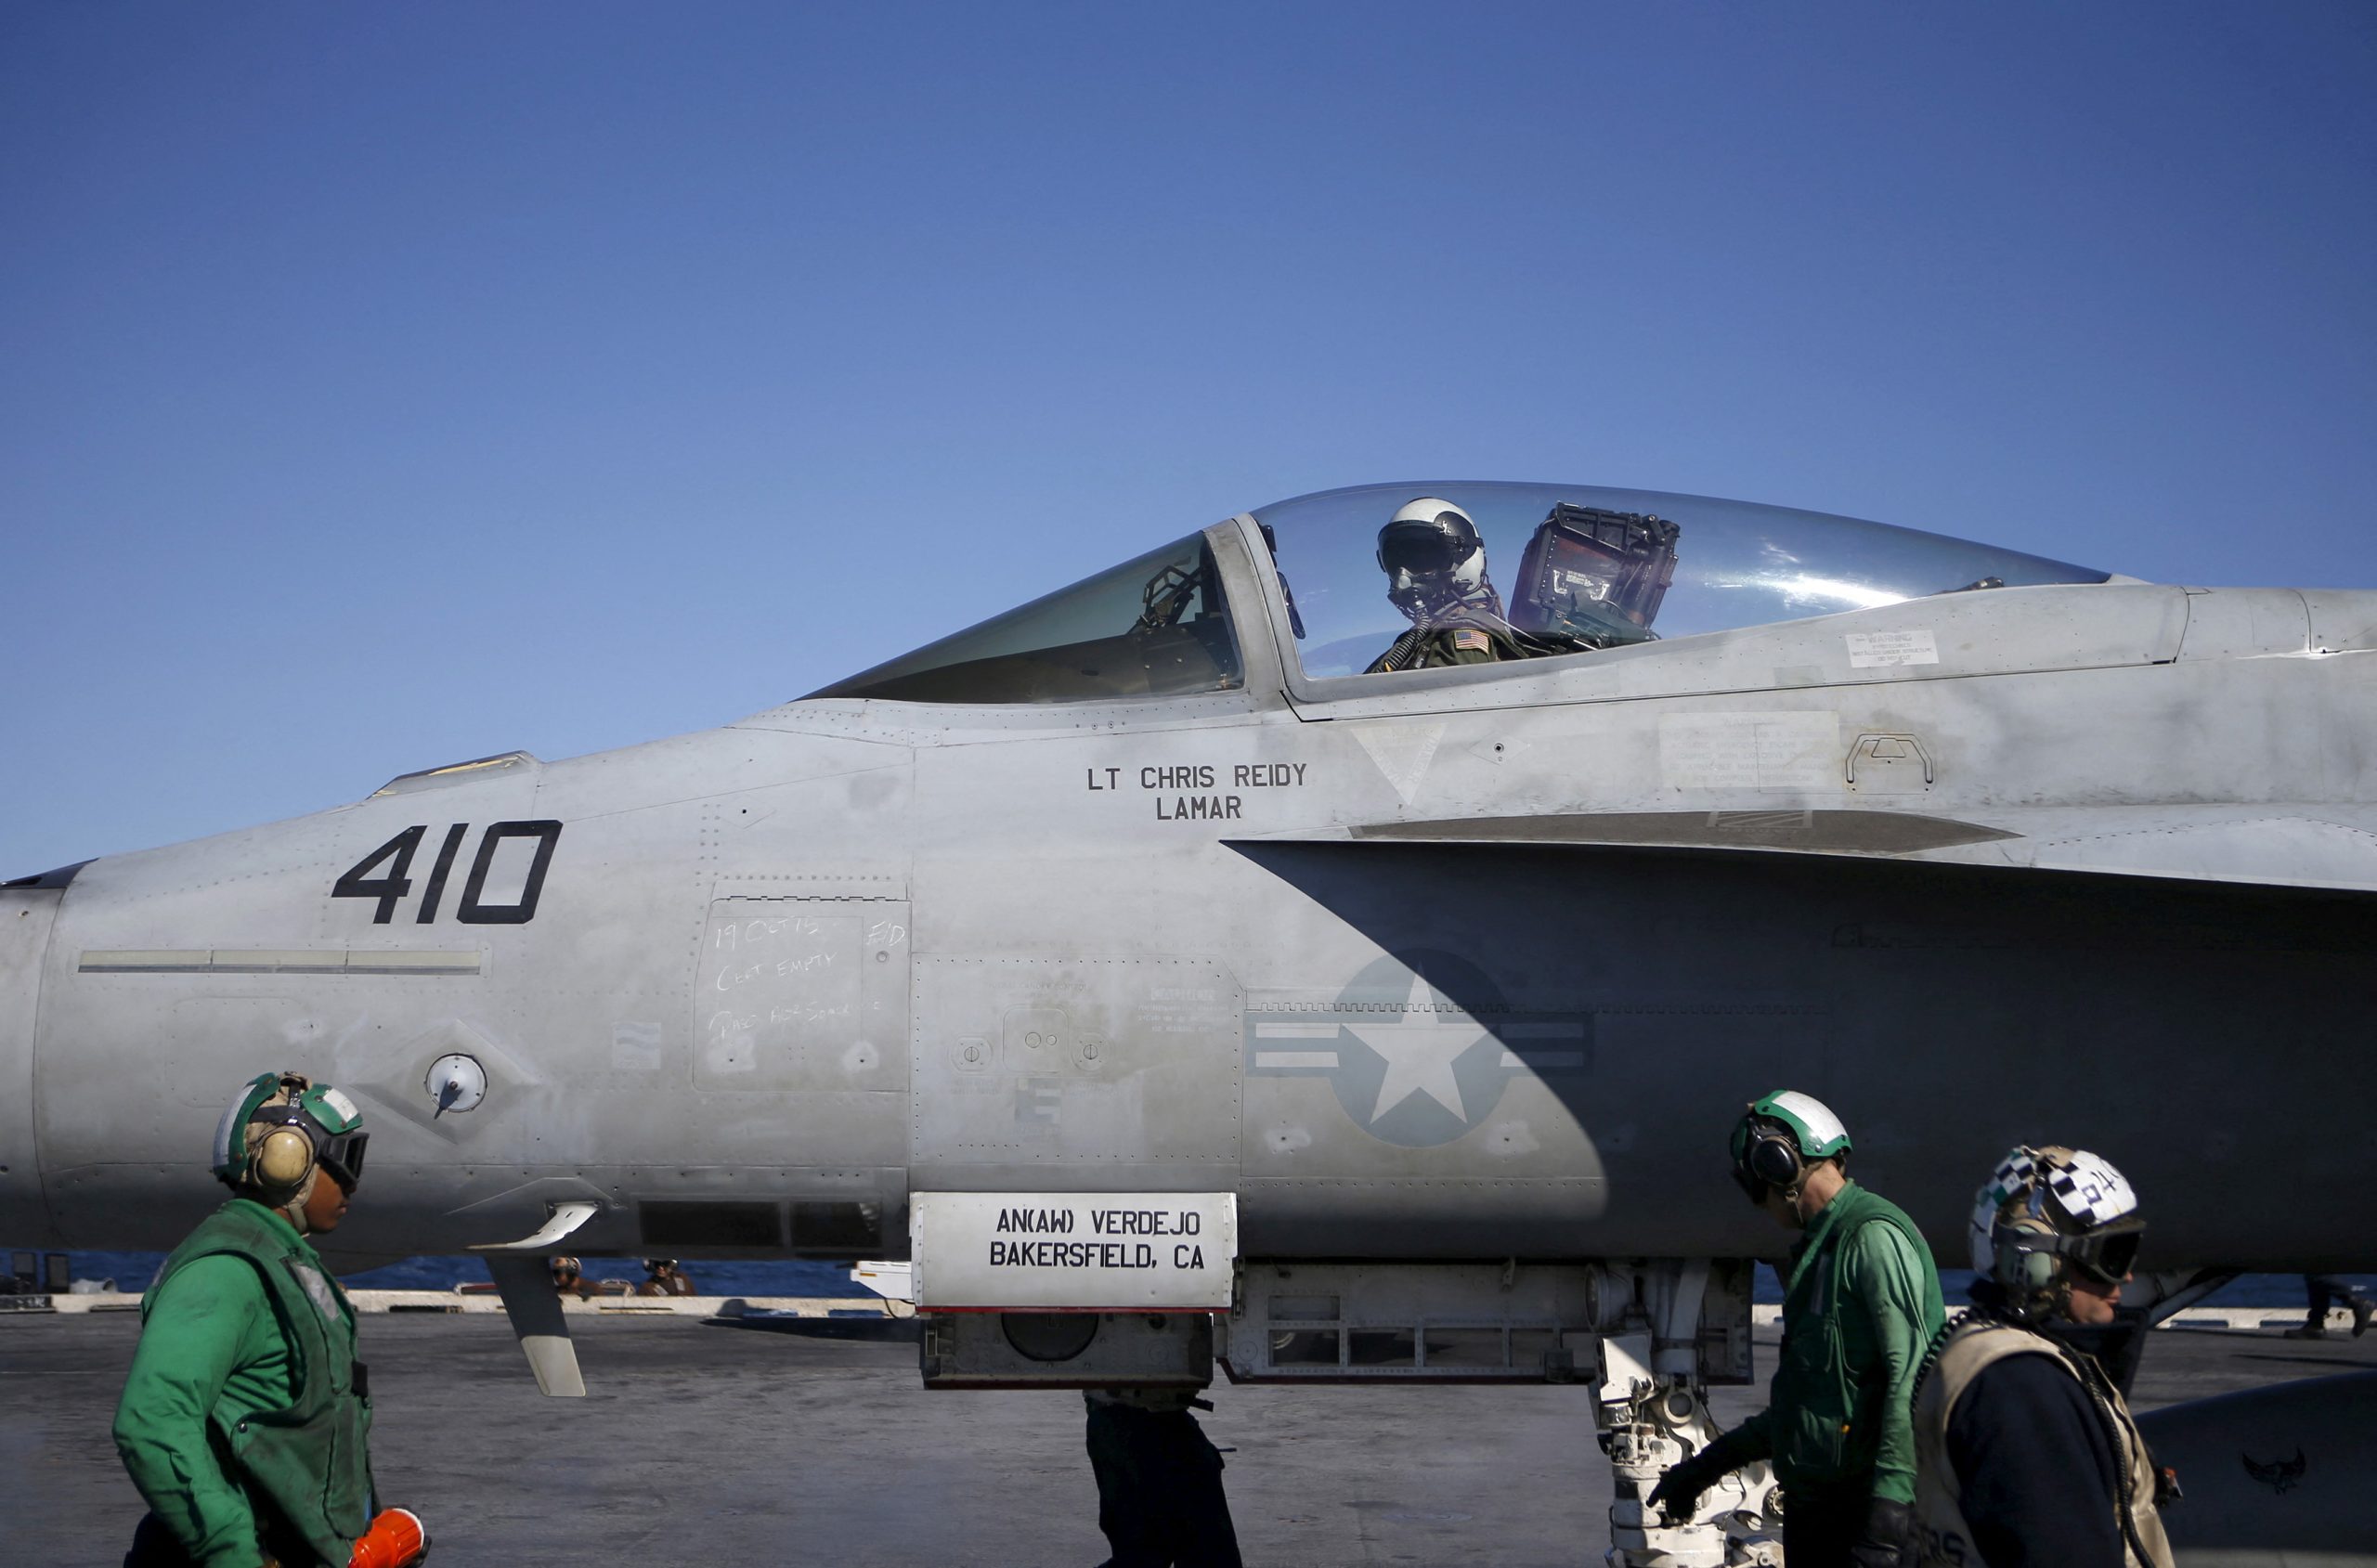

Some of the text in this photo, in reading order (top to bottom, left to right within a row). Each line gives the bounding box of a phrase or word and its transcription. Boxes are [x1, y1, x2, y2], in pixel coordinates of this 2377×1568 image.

[1087, 763, 1307, 790] LT CHRIS REIDY
[1156, 796, 1242, 821] LAMAR
[331, 819, 564, 925] 410
[996, 1208, 1201, 1236] AN(AW) VERDEJO
[990, 1241, 1204, 1269] BAKERSFIELD, CA
